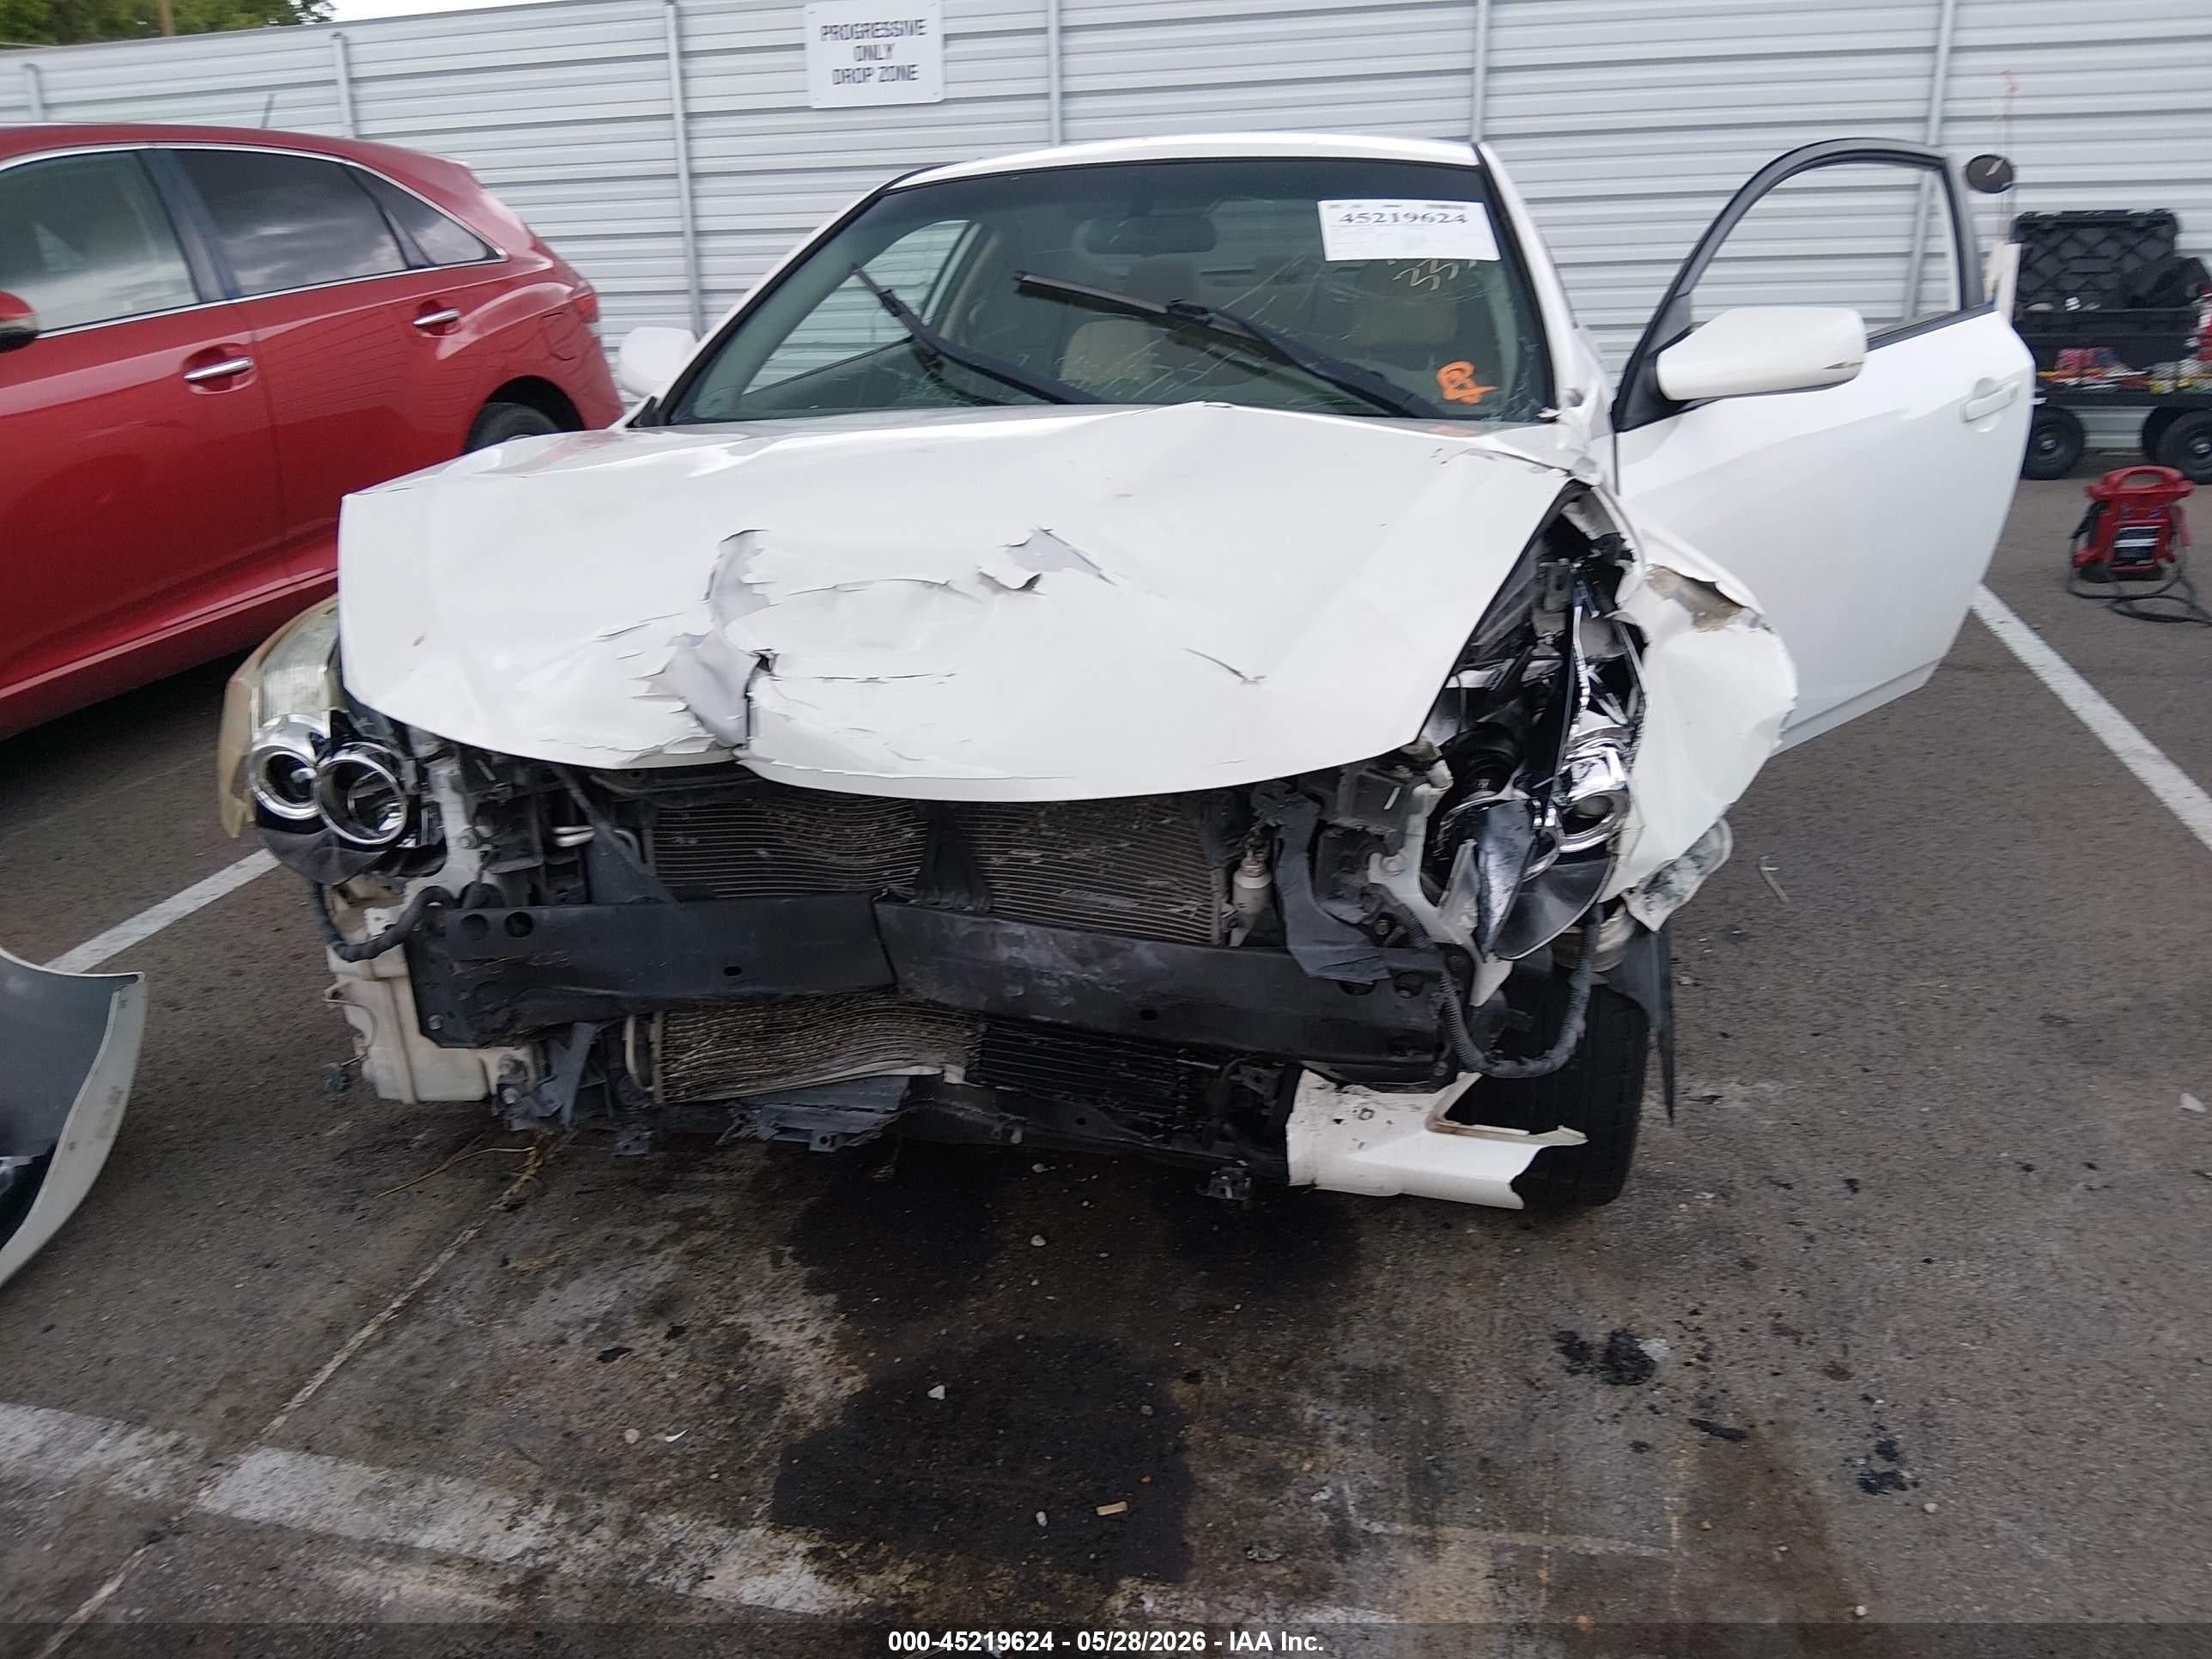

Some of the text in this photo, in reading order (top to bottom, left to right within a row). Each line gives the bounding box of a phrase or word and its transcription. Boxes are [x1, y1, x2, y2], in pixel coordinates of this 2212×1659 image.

[820, 19, 927, 41] PROGRESSIVE
[853, 43, 896, 62] ONLY
[831, 64, 920, 85] DROP ZONE
[1340, 212, 1468, 224] 45219624
